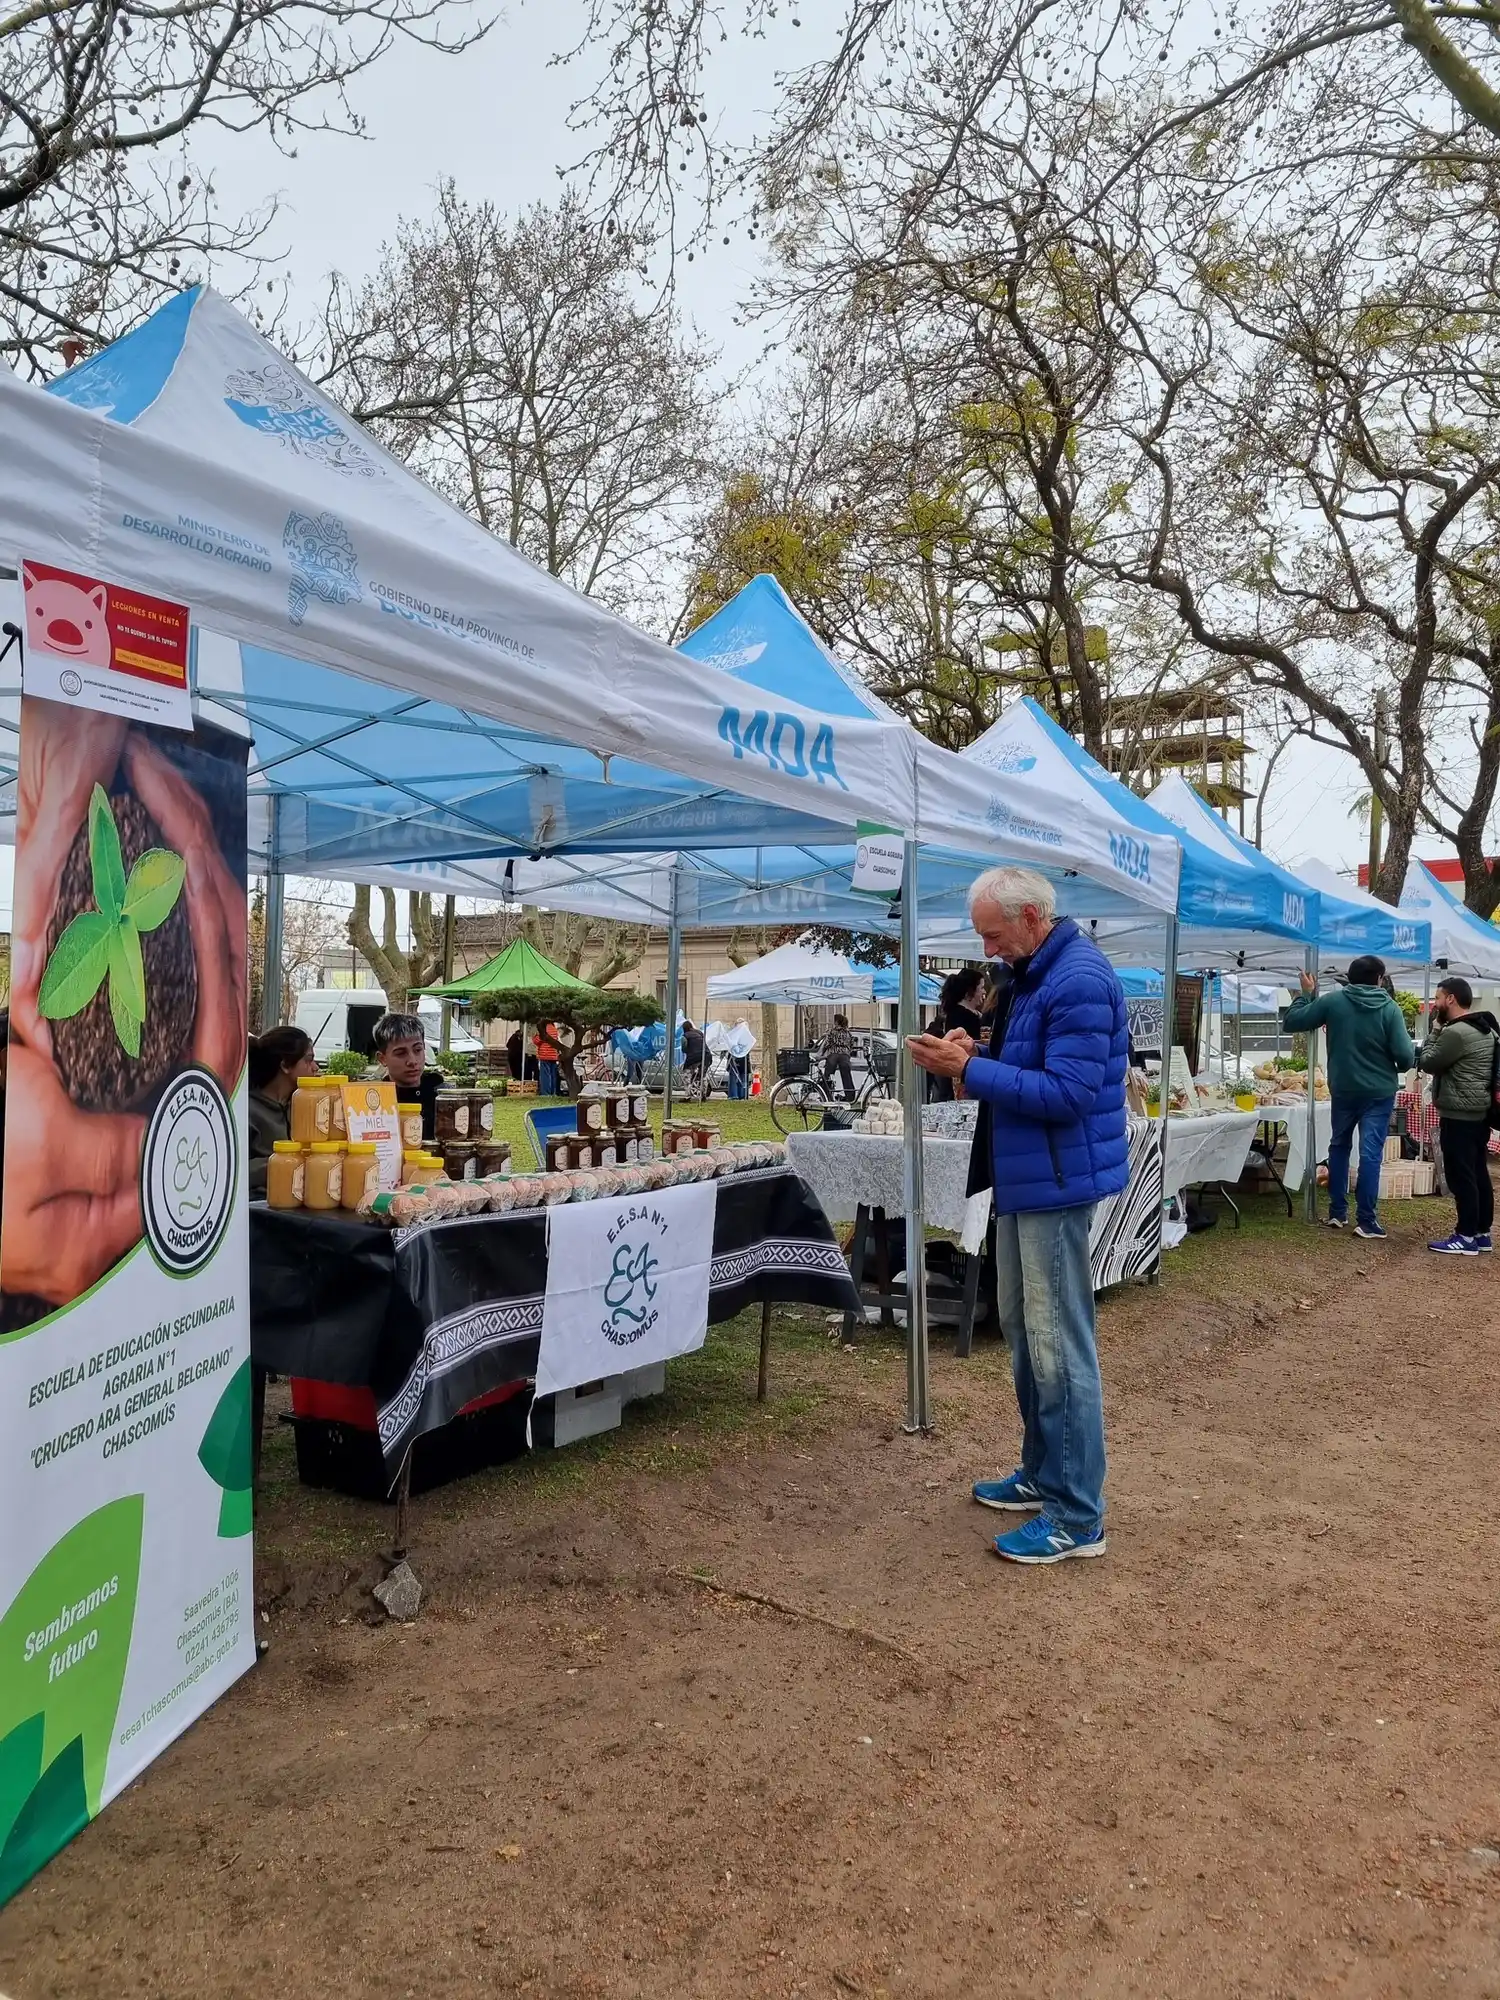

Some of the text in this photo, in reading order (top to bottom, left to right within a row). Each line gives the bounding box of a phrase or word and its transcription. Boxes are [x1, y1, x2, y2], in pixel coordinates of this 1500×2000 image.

[122, 513, 272, 574] DESARROLLO AGRARIO
[178, 514, 271, 557] MINISTERIO DE
[111, 600, 180, 627] LECHONES EN VENTA
[368, 580, 432, 616] GOBIERNO
[434, 606, 449, 622] DE
[450, 613, 465, 629] LA
[466, 620, 519, 653] PROVINCIA
[521, 644, 535, 659] DE
[717, 706, 849, 792] MDA
[1108, 829, 1151, 885] MDA
[1283, 892, 1306, 930] MDA
[810, 976, 845, 989] MDA
[365, 1117, 386, 1129] MIEL
[28, 1295, 235, 1409] ESCUELA DE EDUCACIÓN SECUNDARIA
[96, 1409, 121, 1434] ARA
[124, 1376, 175, 1417] GENERAL
[102, 1361, 154, 1400] AGRARIA
[102, 1402, 176, 1460] CHASCOMÚS
[23, 1574, 119, 1662] Sembramos
[184, 1588, 219, 1622] Saavedra
[223, 1590, 239, 1615] (BA)
[48, 1629, 99, 1684] futuro
[185, 1636, 210, 1665] 02241
